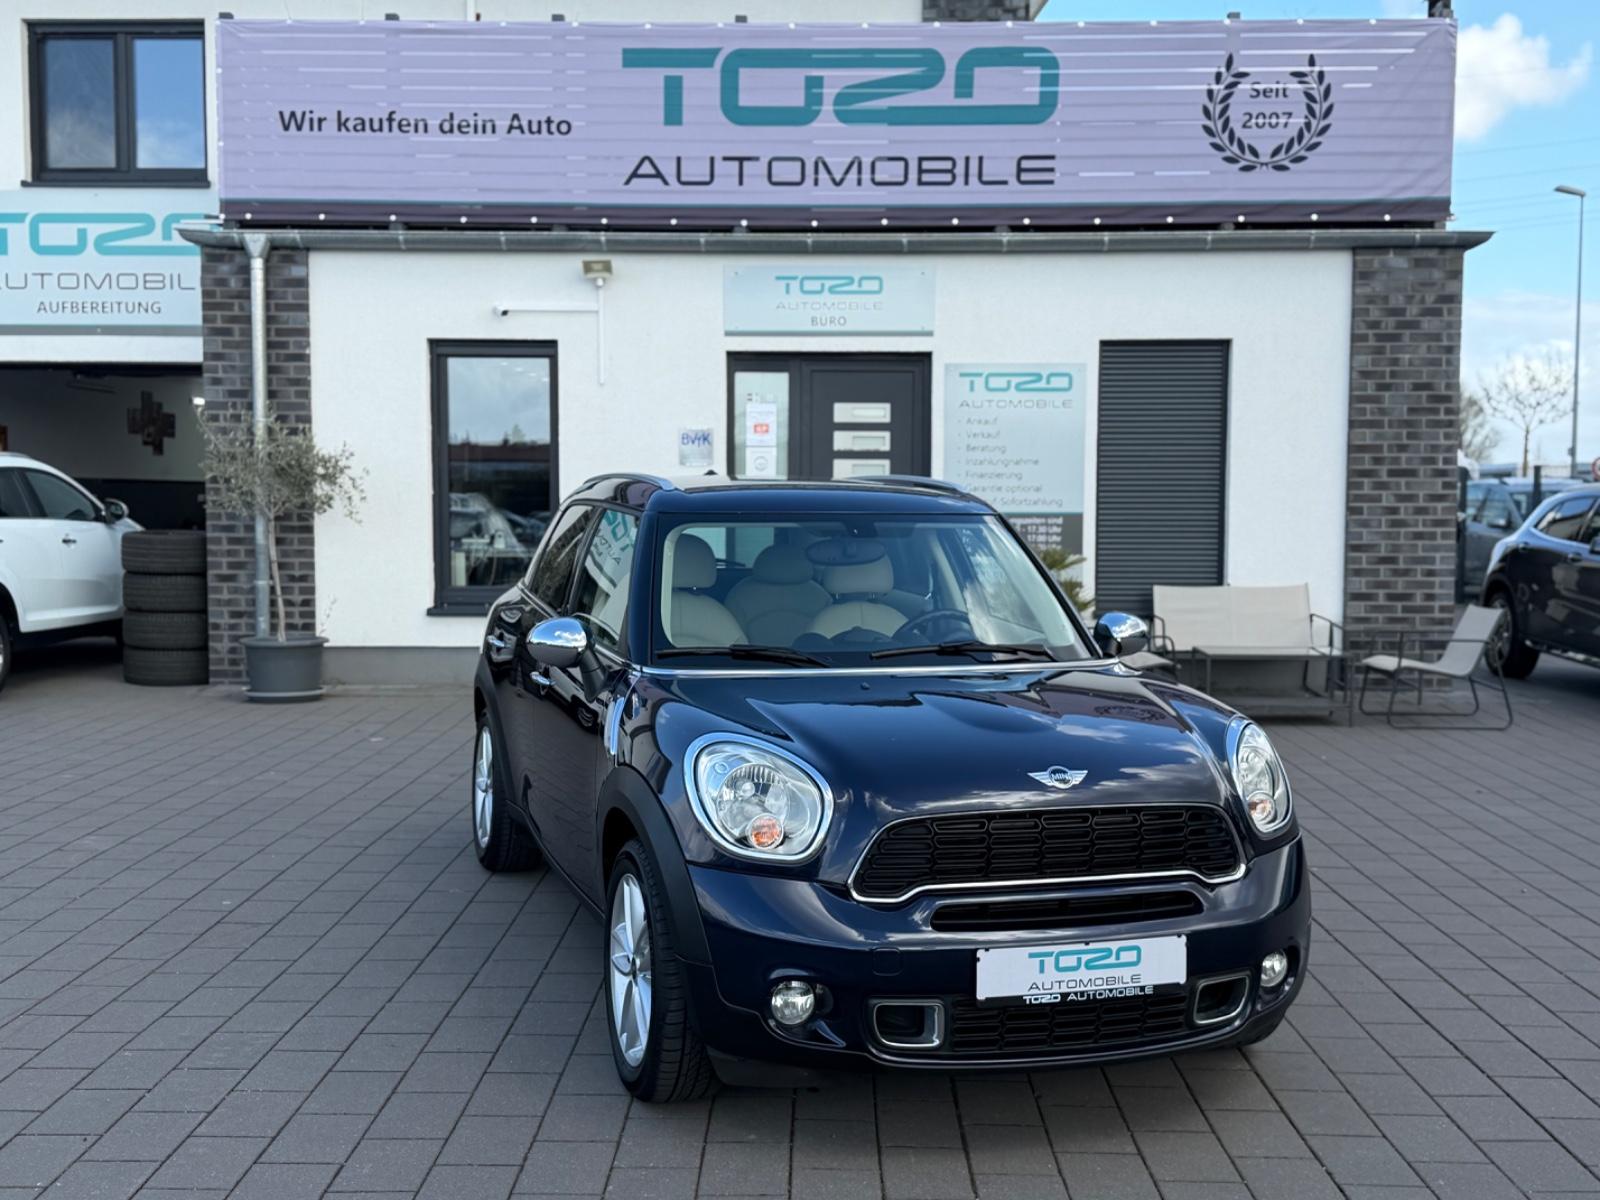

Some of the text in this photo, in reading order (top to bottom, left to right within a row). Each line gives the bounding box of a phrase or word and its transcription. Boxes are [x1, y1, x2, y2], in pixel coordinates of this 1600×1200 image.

[1248, 81, 1290, 99] Seit
[278, 110, 573, 136] Wir kaufen dein Auto
[1241, 111, 1294, 129] 2007
[623, 154, 1057, 187] AUTOMOBILE
[0, 272, 196, 290] UTOMOBIL
[36, 301, 162, 315] AUFBEREITUNG
[775, 301, 883, 311] AUTOMOBILE
[958, 399, 1073, 409] AUTOMOBILE
[965, 444, 1007, 454] Beratung
[1027, 974, 1142, 992] AUTOMOBILE
[1067, 985, 1154, 1002] AUTOMOBILE
